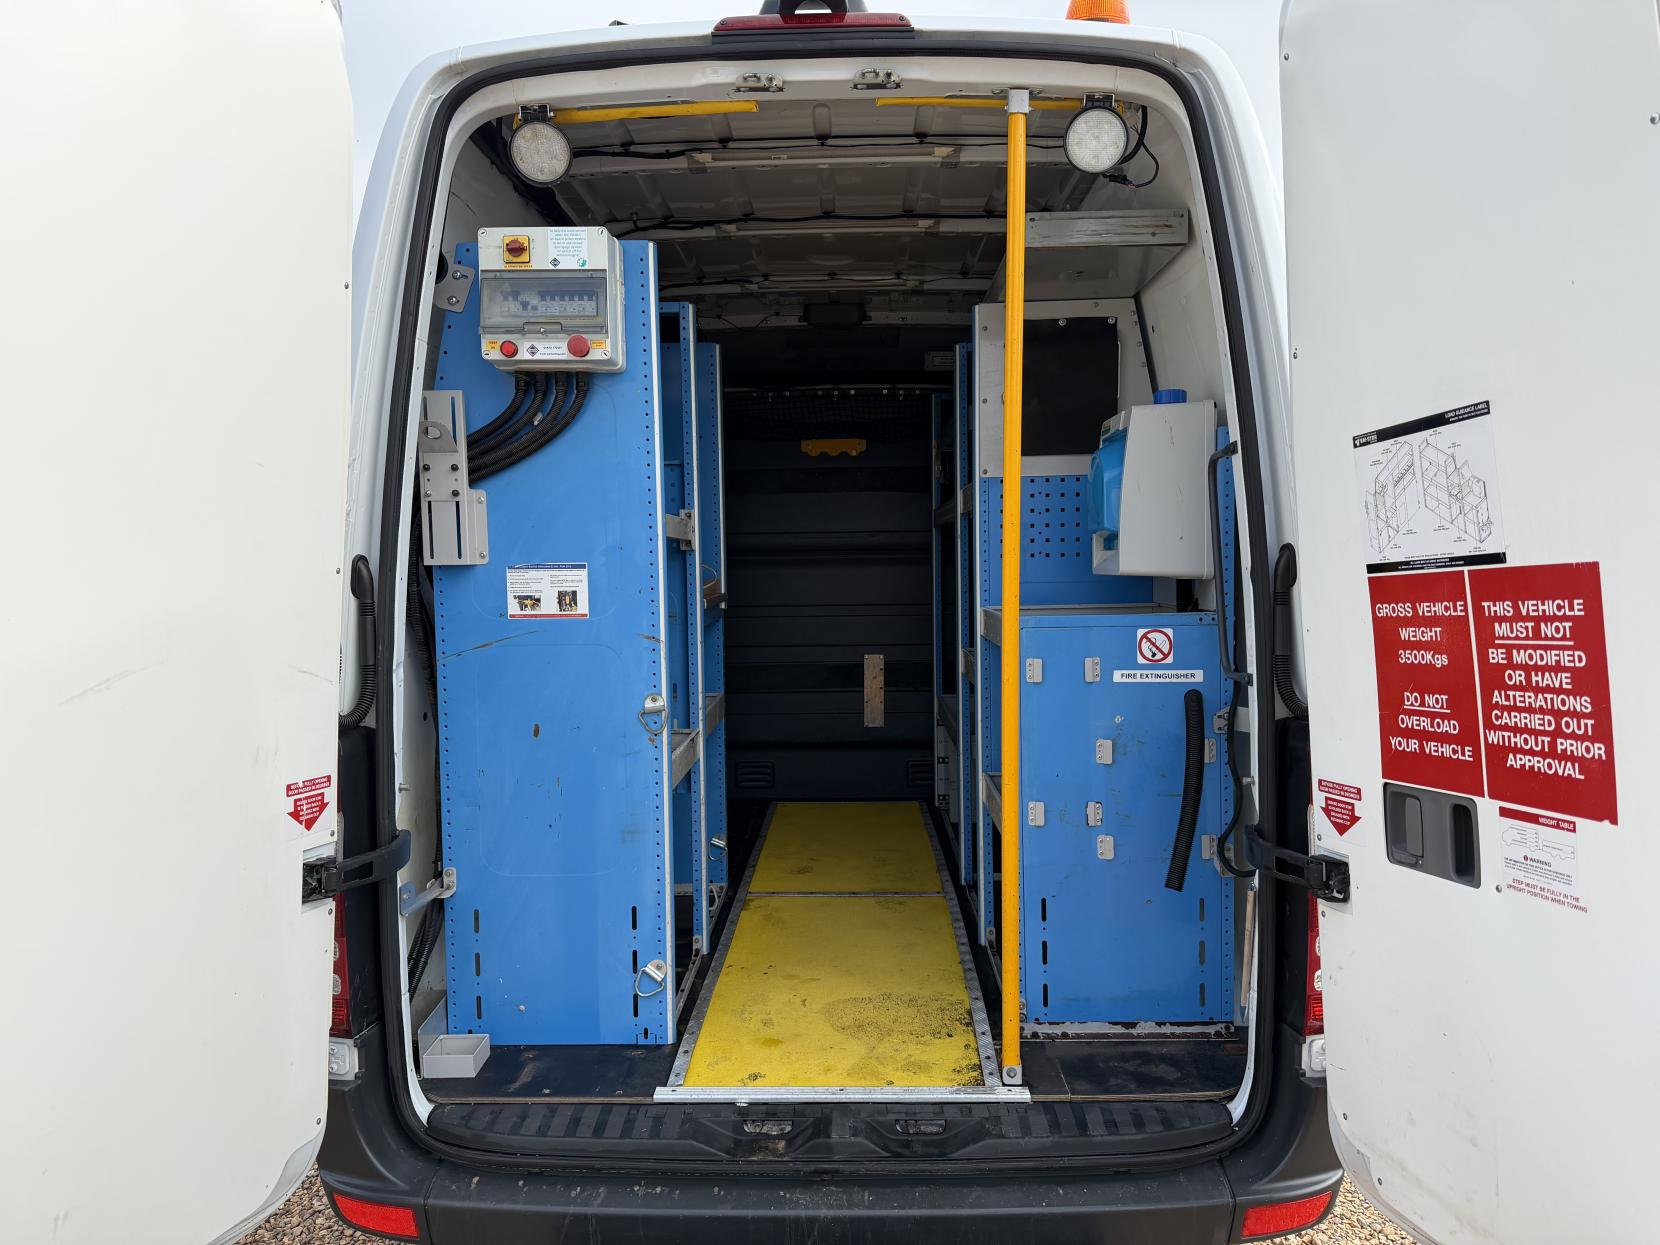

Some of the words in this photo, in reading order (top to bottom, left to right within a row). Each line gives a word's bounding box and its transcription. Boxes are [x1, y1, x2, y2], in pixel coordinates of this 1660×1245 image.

[1475, 402, 1488, 410] LABEL
[1376, 603, 1412, 616] GROSS
[1417, 602, 1465, 616] VEHICLE
[1482, 601, 1513, 616] THIS
[1518, 600, 1584, 616] VEHICLE
[1399, 627, 1442, 641] WEIGHT
[1494, 623, 1534, 637] MUST
[1541, 622, 1572, 638] NOT
[1398, 650, 1448, 668] 3500Kgs
[1488, 648, 1507, 664] BE
[1513, 650, 1586, 667] MODIFIED
[1120, 672, 1138, 680] FIRE
[1140, 672, 1196, 680] EXTINGUISHER
[1504, 670, 1526, 686] OR
[1532, 672, 1572, 689] HAVE
[1404, 692, 1420, 706] DO
[1425, 694, 1448, 708] NOT
[1492, 690, 1592, 713] ALTERATIONS
[1398, 714, 1459, 734] OVERLOAD
[1491, 710, 1555, 731] CARRIED
[1561, 717, 1594, 736] OUT
[1389, 736, 1419, 752] YOUR
[1423, 741, 1473, 761] VEHICLE
[1486, 729, 1550, 752] WITHOUT
[1557, 738, 1606, 760] PRIOR
[1506, 753, 1585, 780] APPROVAL
[1559, 821, 1574, 830] TABLE
[1529, 857, 1552, 868] WARNING
[1524, 881, 1538, 890] MUST
[1539, 884, 1546, 892] BE
[1546, 887, 1562, 897] FULLY
[1569, 894, 1580, 903] THE
[1526, 889, 1550, 901] POSITION
[1550, 895, 1565, 906] WHEN
[1566, 900, 1588, 913] TOWING
